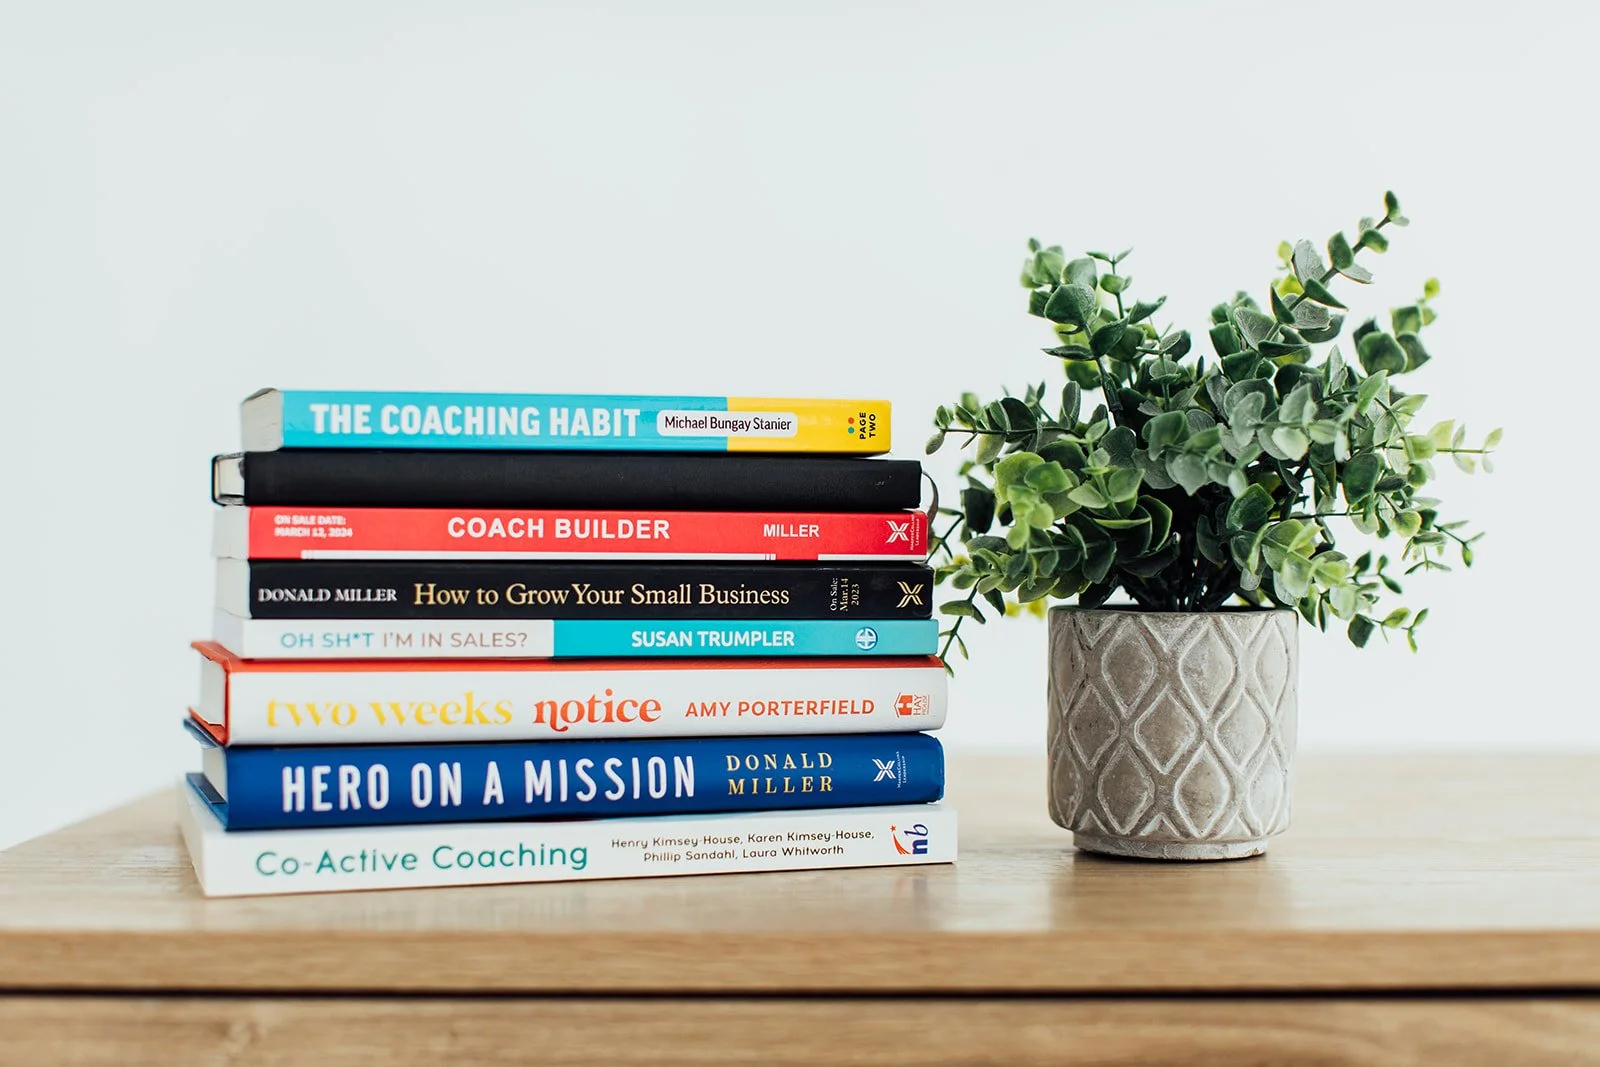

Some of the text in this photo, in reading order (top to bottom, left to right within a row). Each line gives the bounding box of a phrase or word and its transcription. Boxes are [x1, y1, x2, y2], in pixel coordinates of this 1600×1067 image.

[309, 404, 641, 437] THE COACHING HABIT
[665, 415, 792, 432] Michael Bungay Stanier
[859, 412, 867, 440] PAGE
[274, 515, 291, 525] ON
[447, 517, 671, 539] COACH BUILDER
[762, 523, 821, 538] MILLER
[257, 587, 398, 602] DONALD MILLER
[413, 583, 790, 606] How to Grow Your Small Business
[830, 577, 838, 611] On Sale:
[851, 583, 860, 606] 2023
[280, 632, 315, 648] OH
[383, 632, 417, 648] I'M
[422, 632, 443, 648] IN
[450, 632, 528, 648] SALES?
[630, 631, 796, 648] SUSAN TRUMPLER
[266, 688, 662, 732] two weeks notice
[684, 699, 875, 717] AMY PORTERFIELD
[913, 693, 922, 716] HAY
[725, 751, 833, 772] DONALD
[281, 755, 695, 813] HERO ON A MISSION
[727, 776, 834, 796] MILLER
[611, 829, 875, 850] Henry Kimsey-House, Karen Kimsey-House,
[255, 842, 588, 876] Co-Active Coaching
[643, 845, 845, 863] Phillip Sandahl, Laura Whitworth
